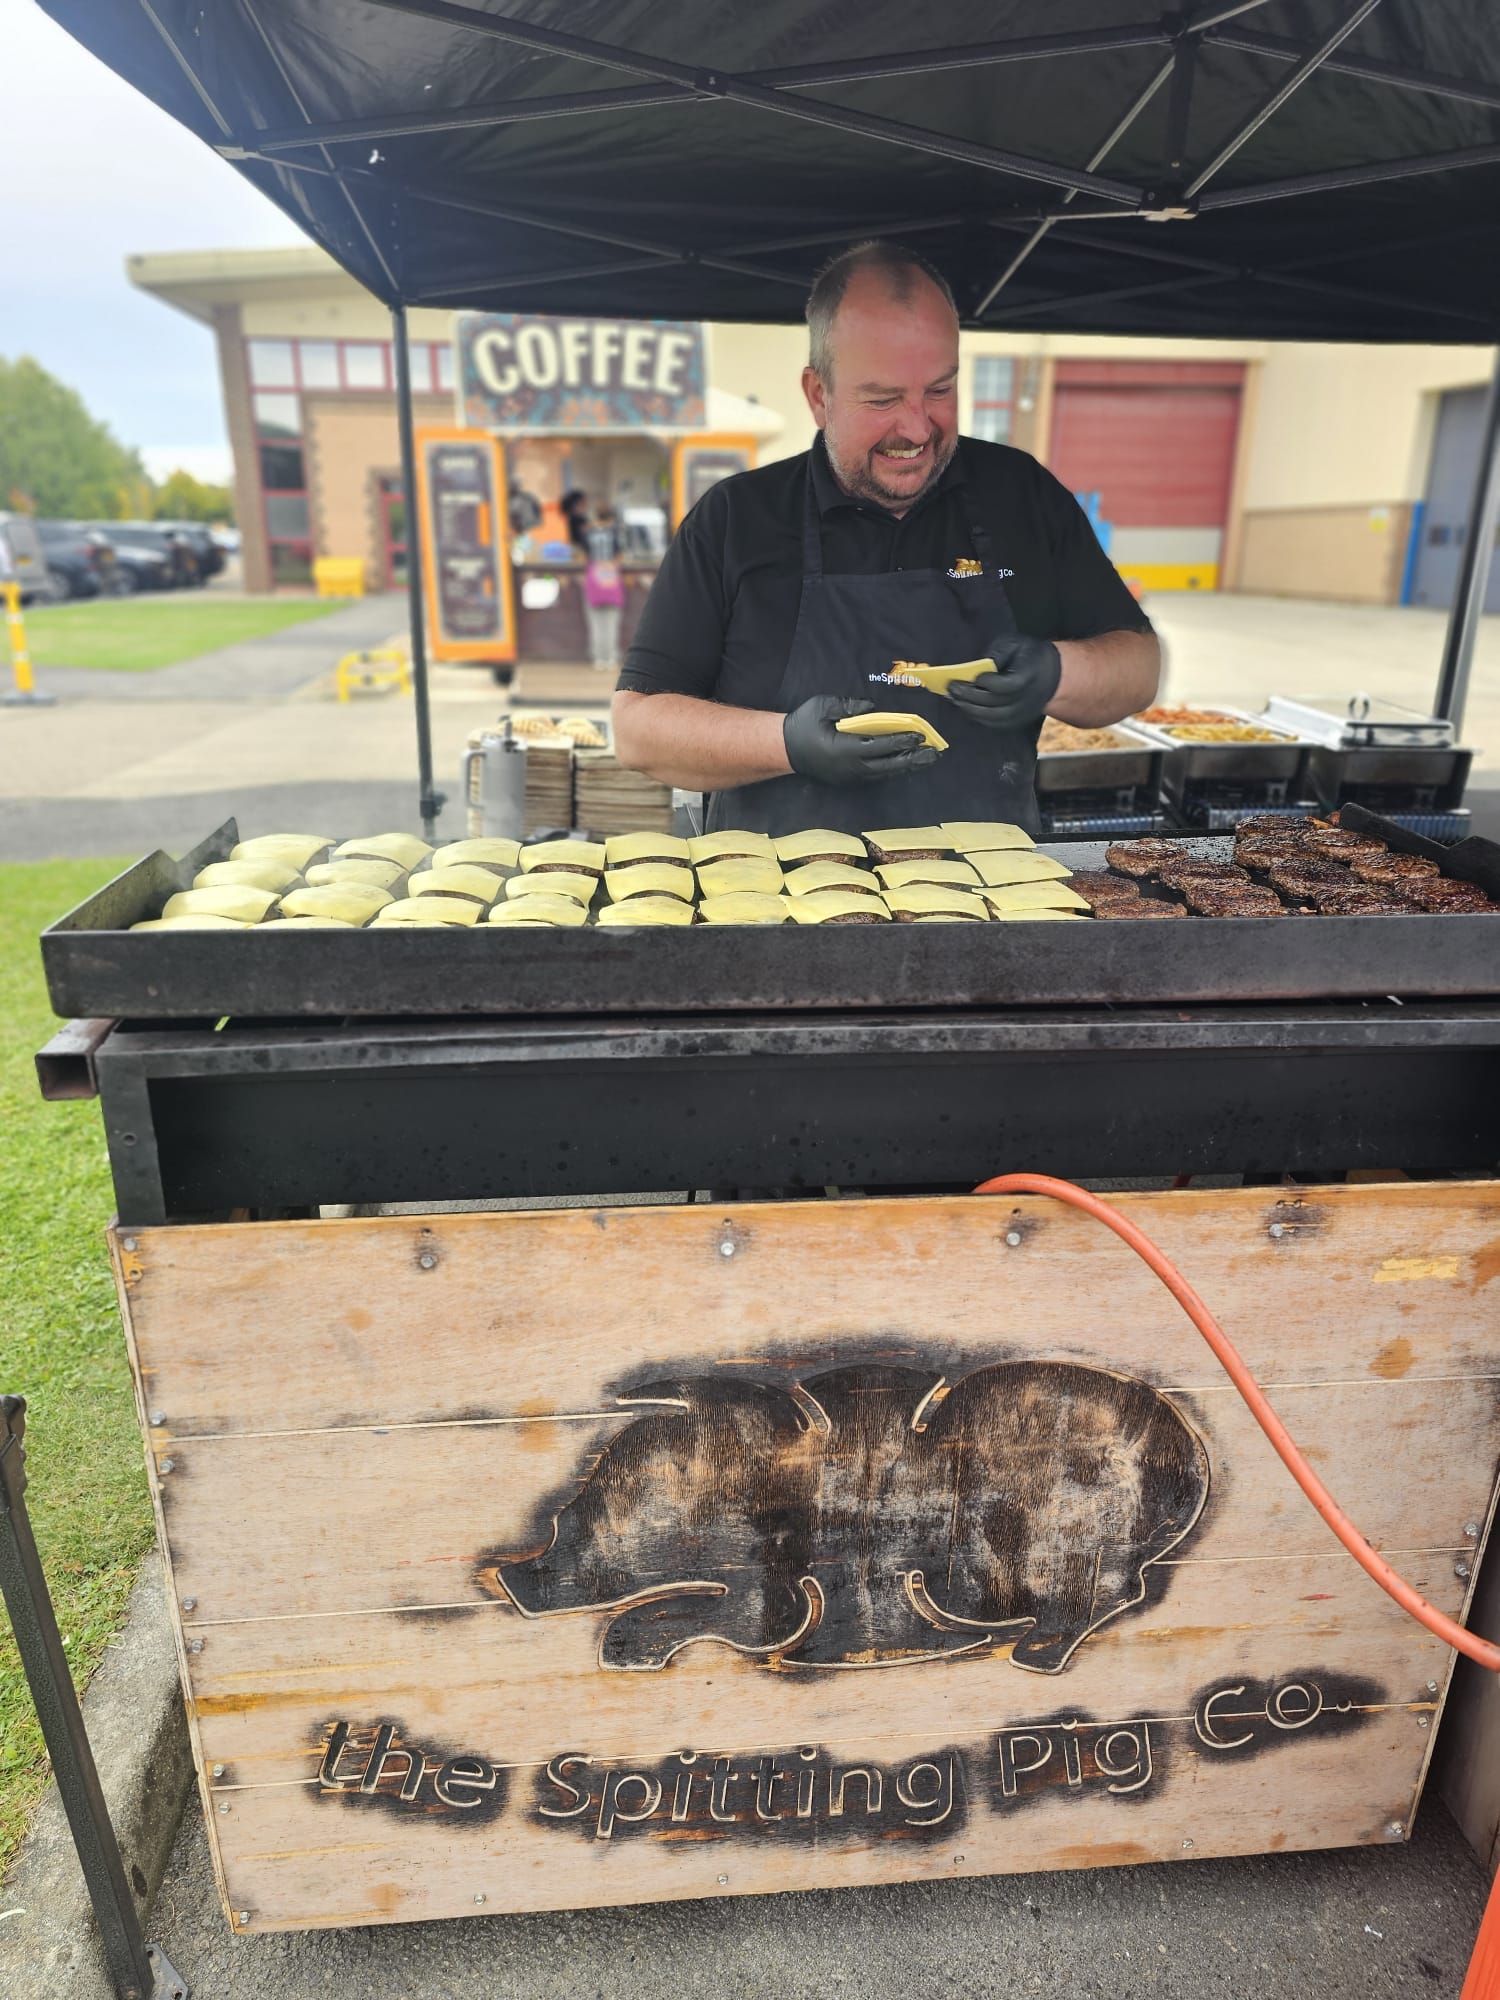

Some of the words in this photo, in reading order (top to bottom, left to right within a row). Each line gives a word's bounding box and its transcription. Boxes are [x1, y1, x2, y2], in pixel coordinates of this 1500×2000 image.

[474, 323, 693, 395] COFFEE
[318, 1720, 498, 1808] the
[538, 1747, 954, 1840] Spitting
[998, 1717, 1153, 1797] Pig
[1194, 1679, 1352, 1750] Co.
